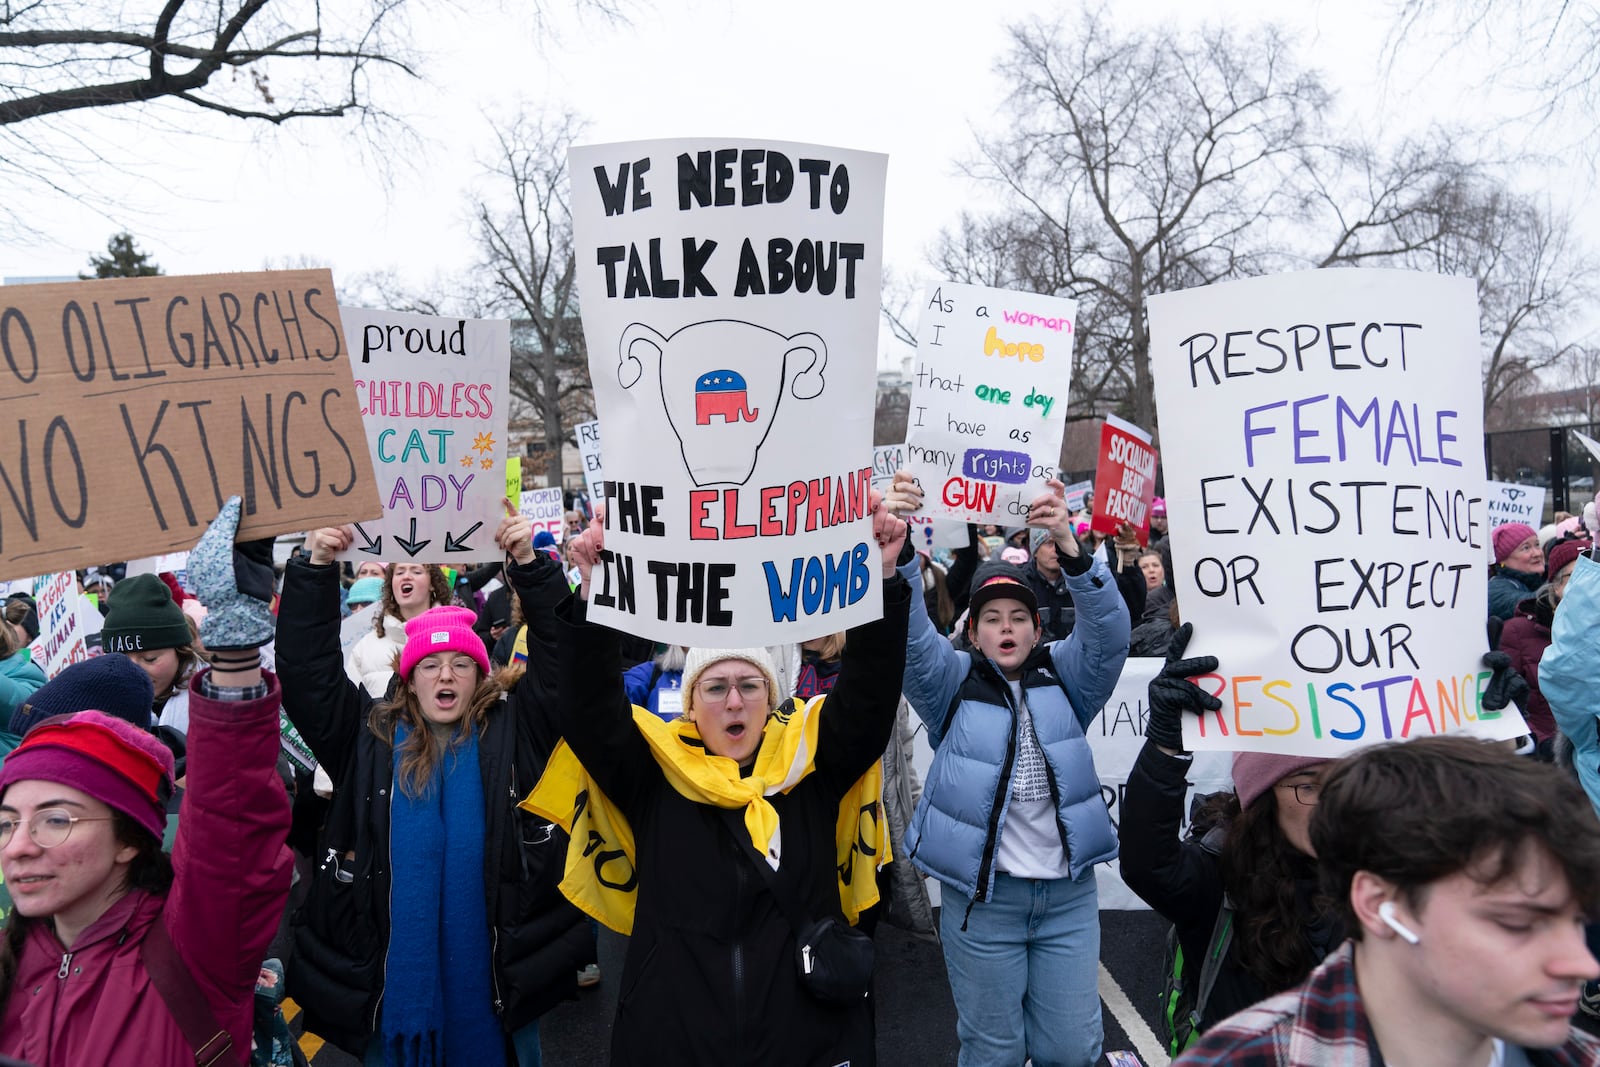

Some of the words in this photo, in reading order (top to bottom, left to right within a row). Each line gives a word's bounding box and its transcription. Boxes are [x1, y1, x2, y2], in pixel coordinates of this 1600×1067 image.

[594, 156, 652, 217] WE
[677, 148, 795, 211] NEED
[799, 158, 850, 215] TO
[596, 237, 718, 299] TALK
[734, 237, 865, 300] ABOUT
[929, 287, 954, 313] As
[976, 305, 990, 318] a
[1003, 310, 1072, 333] woman
[62, 288, 340, 382] OLIGARCHS
[361, 320, 466, 363] proud
[929, 324, 946, 346] I
[984, 326, 1045, 363] hope
[1179, 321, 1423, 388] RESPECT
[353, 379, 493, 419] CHILDLESS
[916, 362, 965, 393] that
[975, 384, 1012, 405] one
[1023, 386, 1055, 420] day
[378, 428, 455, 464] CAT
[914, 406, 928, 427] I
[947, 413, 986, 438] have
[1009, 428, 1032, 444] as
[1244, 393, 1463, 468] FEMALE
[0, 415, 88, 551] NO
[120, 388, 357, 531] KINGS
[908, 443, 956, 477] many
[971, 452, 1027, 478] rights
[1032, 464, 1054, 480] as
[1108, 433, 1155, 480] SOCIALISM
[382, 473, 475, 511] ADY
[523, 489, 560, 504] WORLD
[603, 480, 665, 537] THE
[689, 467, 873, 541] ELEPHANT
[942, 477, 997, 514] GUN
[1121, 467, 1144, 498] BEATS
[536, 504, 560, 519] OUR
[1201, 474, 1482, 549] EXISTENCE
[1488, 500, 1534, 515] KINDLY
[593, 549, 636, 615] IN
[647, 560, 736, 627] THE
[762, 542, 870, 623] WOMB
[1194, 555, 1265, 605] OR
[1314, 558, 1472, 612] EXPECT
[50, 598, 66, 633] ARE
[44, 612, 76, 667] HUMAN
[1290, 623, 1419, 674] OUR
[1186, 671, 1503, 740] RESISTANCE
